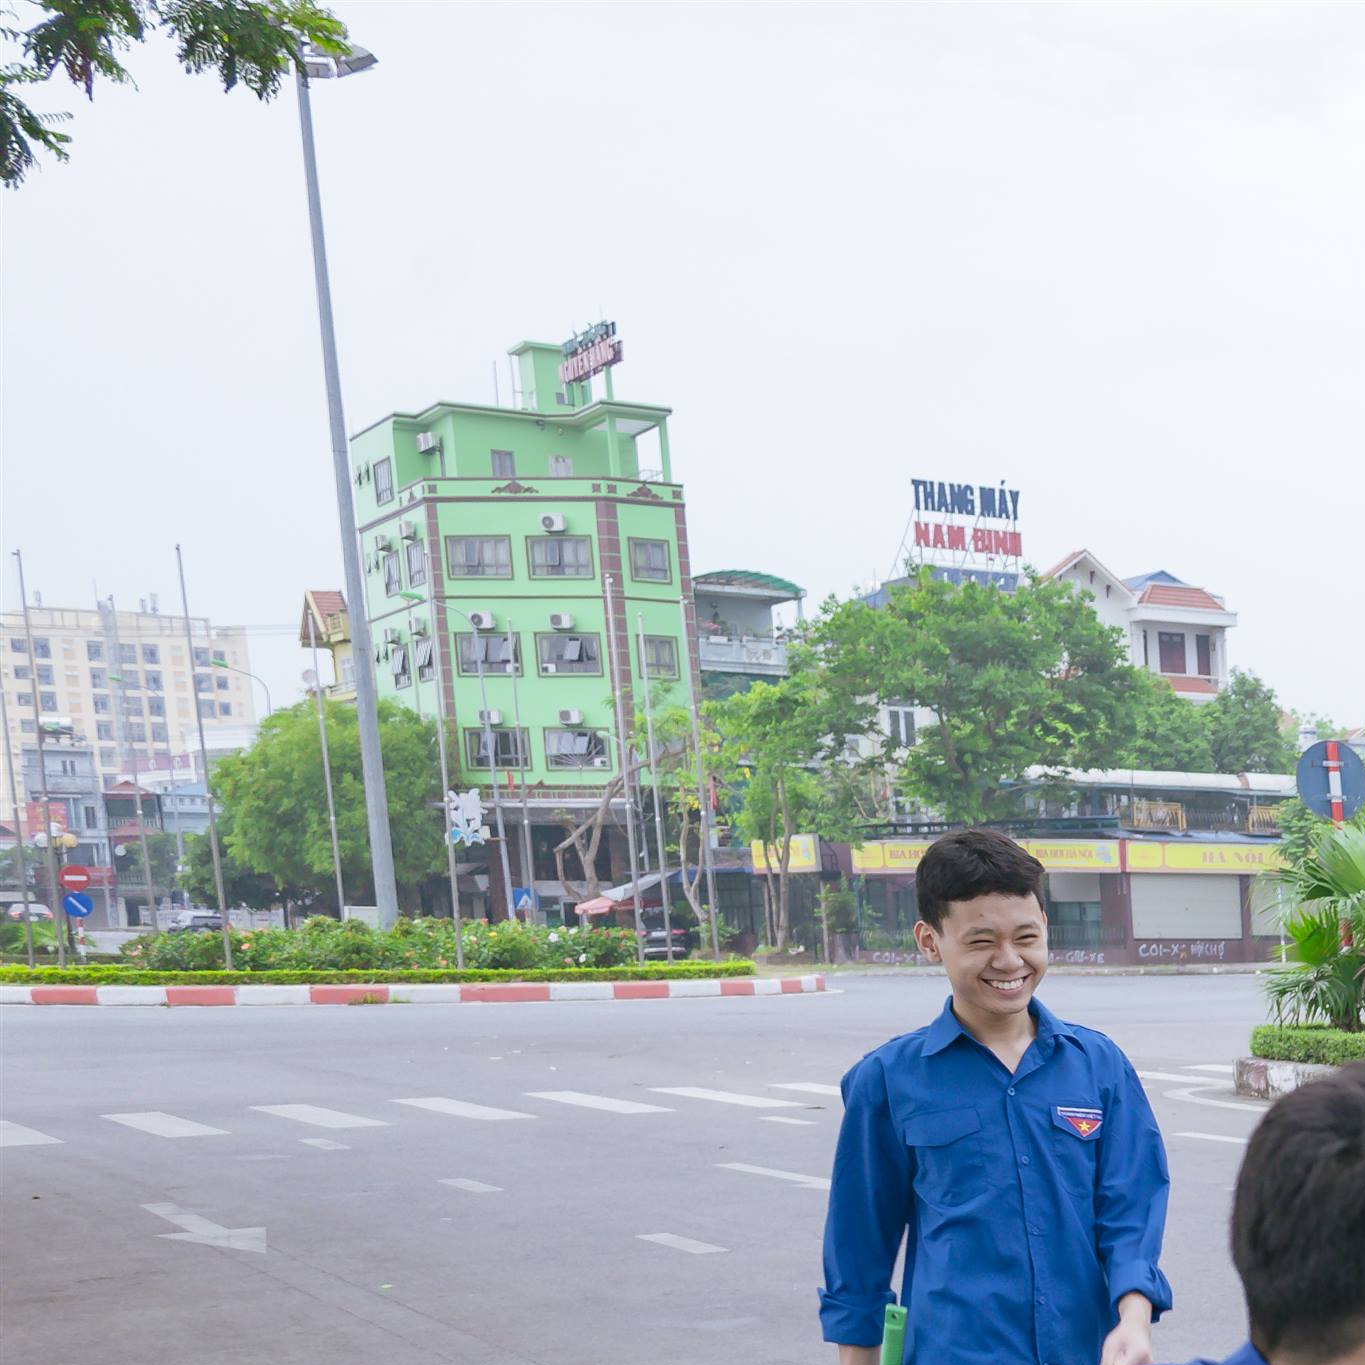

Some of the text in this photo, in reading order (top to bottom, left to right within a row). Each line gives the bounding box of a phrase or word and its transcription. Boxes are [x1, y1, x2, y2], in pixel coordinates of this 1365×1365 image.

[911, 478, 1020, 521] THANG MÁY
[914, 521, 968, 552] NAM
